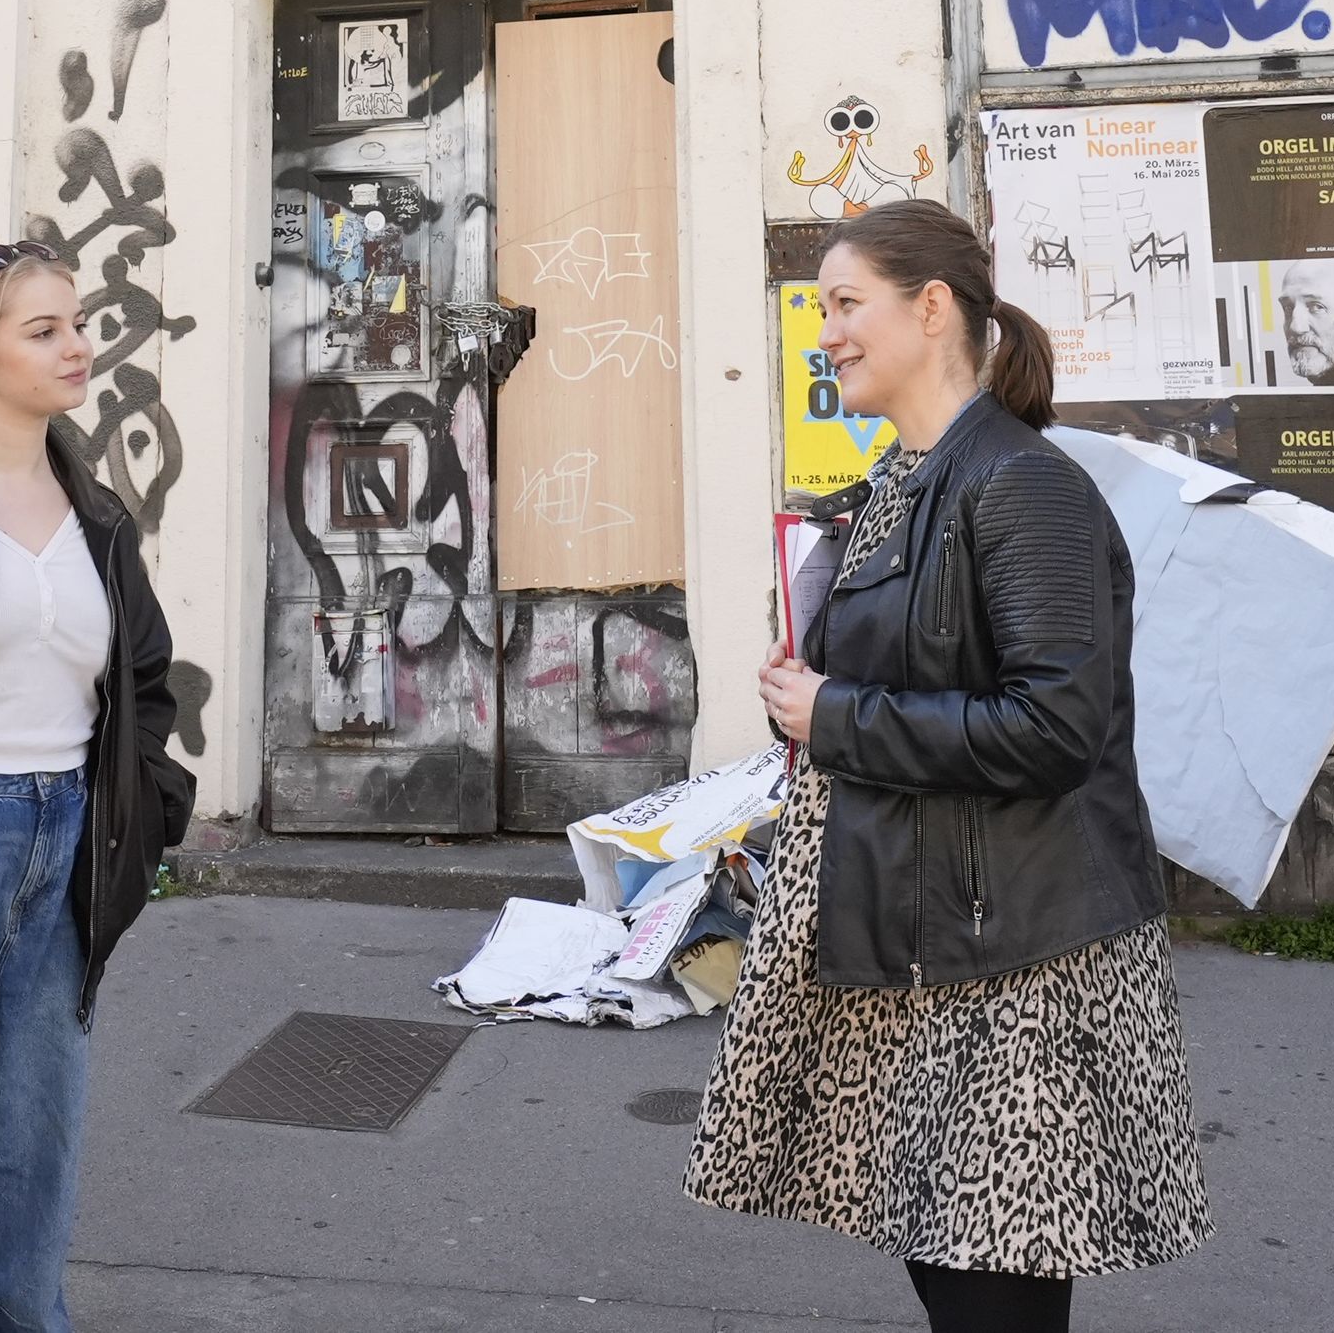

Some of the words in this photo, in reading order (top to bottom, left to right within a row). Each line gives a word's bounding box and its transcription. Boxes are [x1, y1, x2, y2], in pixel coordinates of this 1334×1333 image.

[996, 122, 1030, 140] Art
[1036, 122, 1076, 139] van
[1085, 117, 1156, 137] Linear
[997, 143, 1057, 162] Triest
[1087, 136, 1198, 159] Nonlinear
[1259, 138, 1319, 155] ORGEL
[1145, 160, 1162, 169] 20.
[1133, 171, 1149, 180] 16.
[1152, 170, 1172, 180] Mai
[1174, 168, 1200, 179] 2025
[1080, 351, 1111, 363] 2025
[1162, 359, 1214, 370] gezwanzig
[1282, 450, 1299, 458] KARL
[1299, 450, 1331, 458] MARKOVIC
[791, 474, 825, 485] 11.-25.
[620, 902, 673, 965] VIER
